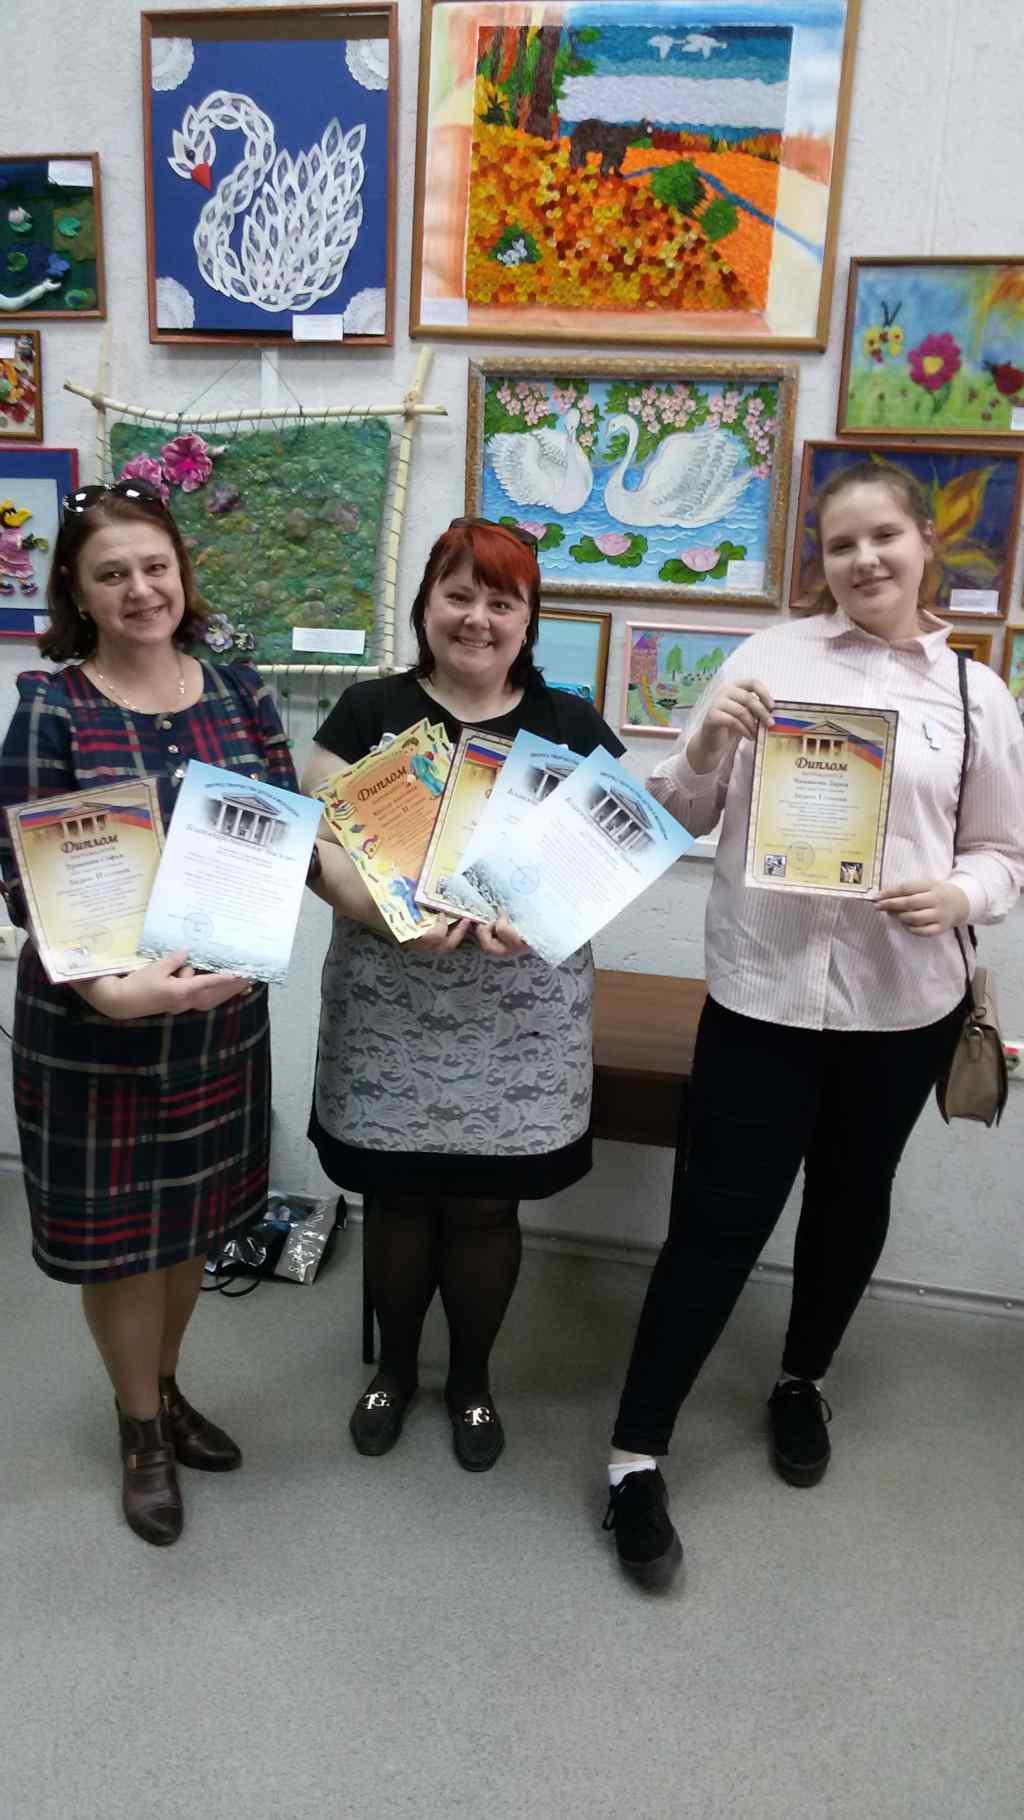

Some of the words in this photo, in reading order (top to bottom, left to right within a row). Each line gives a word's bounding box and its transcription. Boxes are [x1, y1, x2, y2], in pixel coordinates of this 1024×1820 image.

[794, 756, 849, 772] Диплом
[357, 765, 408, 802] Диплом
[60, 834, 119, 854] Диплом
